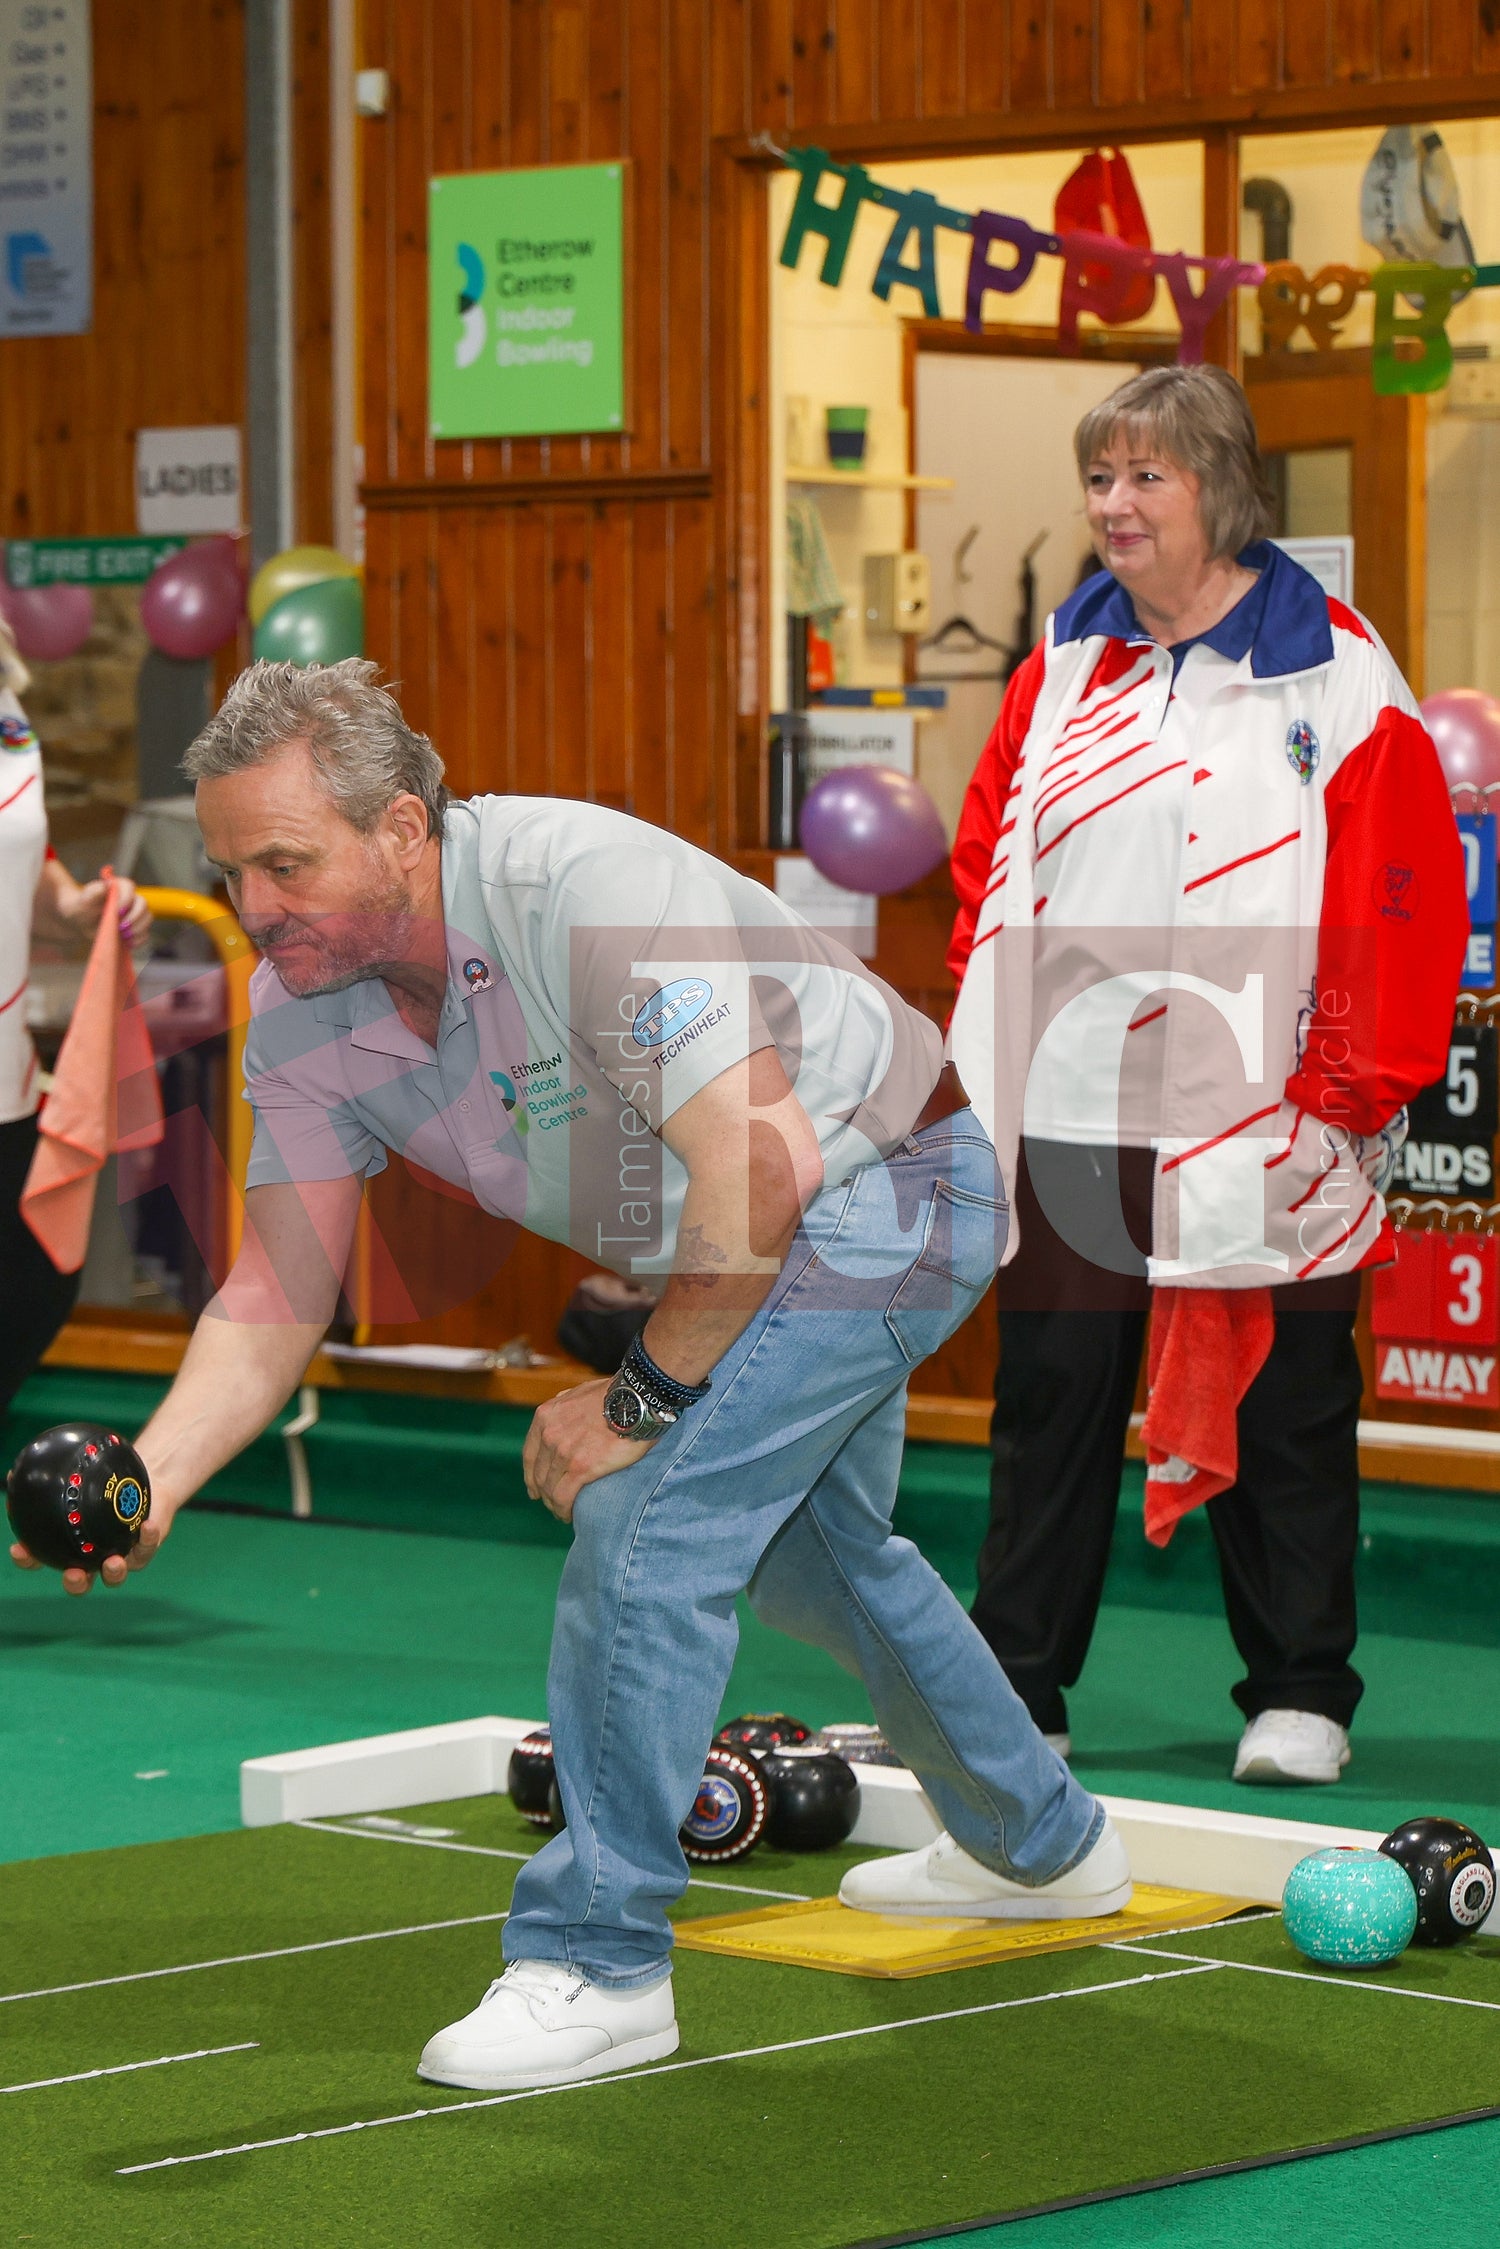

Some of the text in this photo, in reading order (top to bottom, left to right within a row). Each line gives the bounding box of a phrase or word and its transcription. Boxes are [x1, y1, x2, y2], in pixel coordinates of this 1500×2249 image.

[497, 238, 594, 265] Etherow
[779, 146, 1264, 365] HAPPY
[497, 272, 575, 298] Centre
[497, 304, 575, 331] Indoor
[496, 336, 593, 367] Bowling
[140, 464, 237, 497] LADIES
[38, 547, 150, 577] FIRE EXIT
[638, 983, 705, 1038] TPS
[652, 1003, 731, 1071] TECHNIHEAT
[510, 1052, 563, 1079] Etherow
[1446, 1045, 1479, 1117] 5
[519, 1077, 561, 1098] Indoor
[527, 1084, 588, 1115] Bowling
[538, 1106, 588, 1131] Centre
[1448, 1255, 1482, 1326] 3
[1381, 1346, 1496, 1394] AWAY
[104, 1472, 118, 1499] ACE
[130, 1486, 148, 1531] TAYLOR
